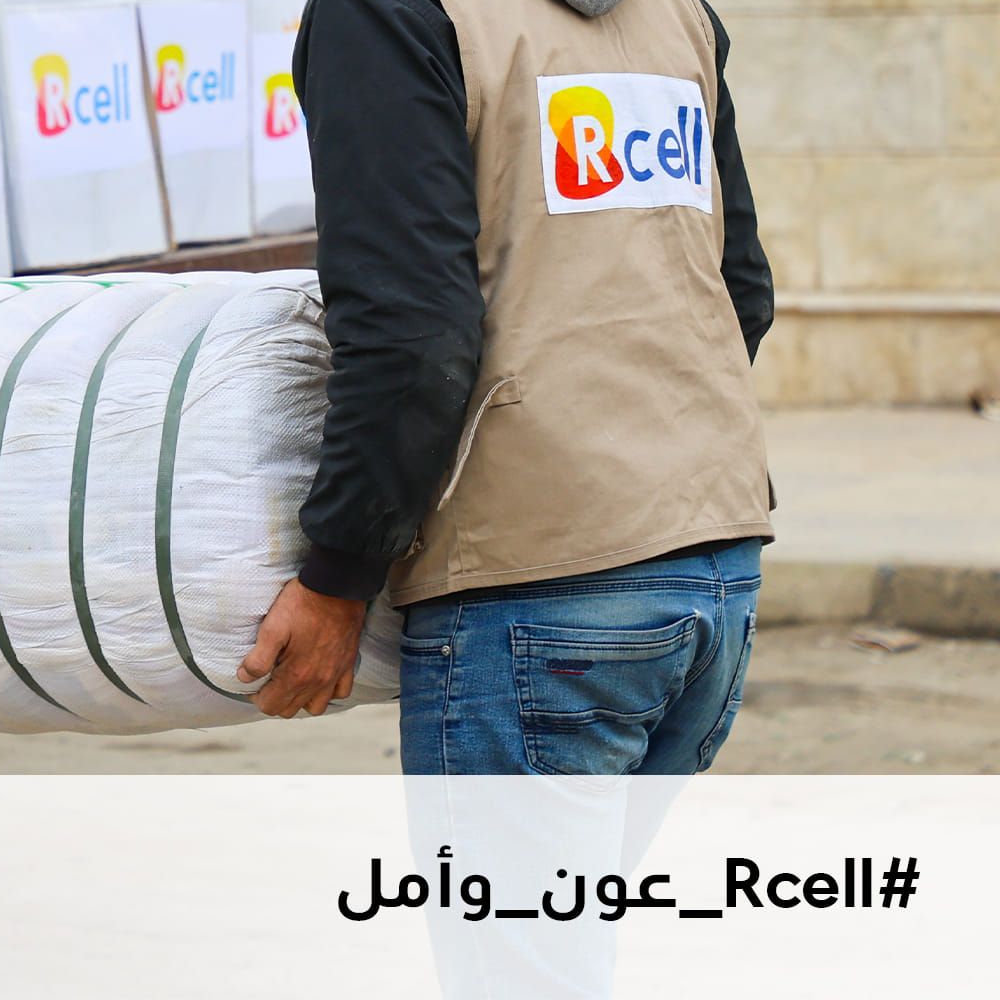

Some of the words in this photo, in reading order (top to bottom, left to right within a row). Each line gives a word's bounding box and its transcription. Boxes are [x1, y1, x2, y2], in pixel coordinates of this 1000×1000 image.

[39, 65, 132, 130] Rcell
[156, 53, 237, 107] Rcell
[572, 105, 702, 186] Rcell
